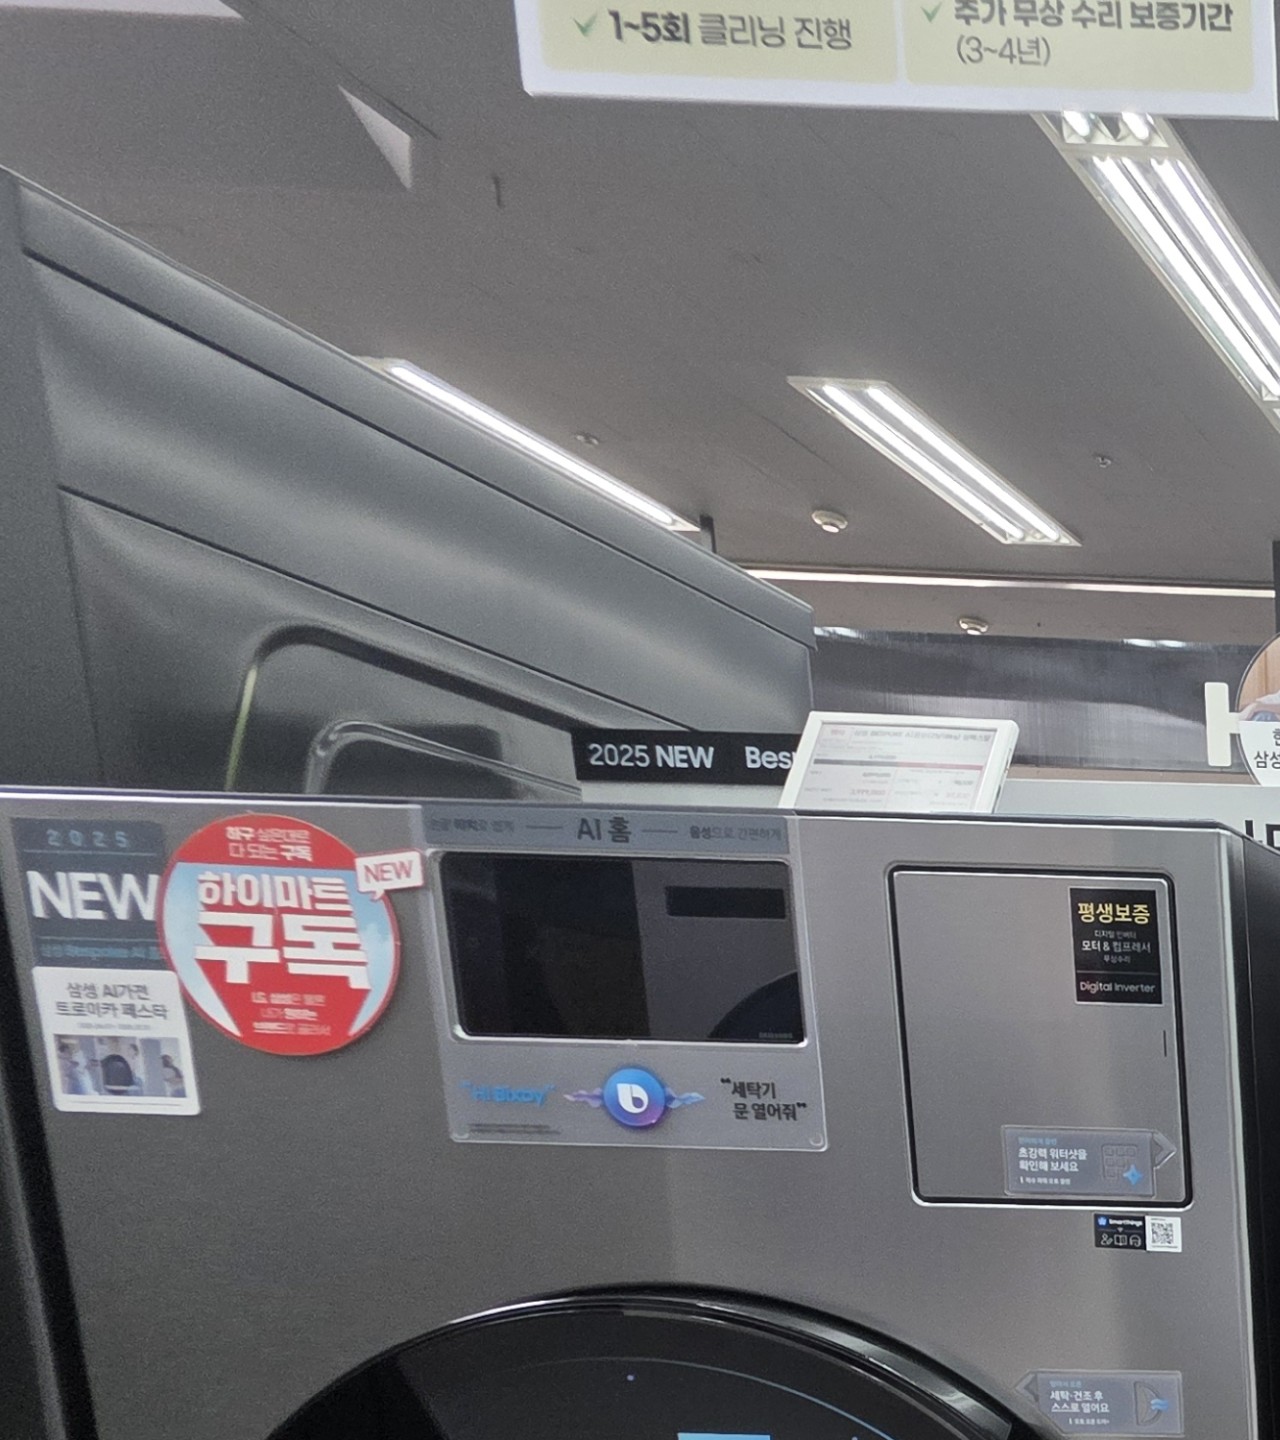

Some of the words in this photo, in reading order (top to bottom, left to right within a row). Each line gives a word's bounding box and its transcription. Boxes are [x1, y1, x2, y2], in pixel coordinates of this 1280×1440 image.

[607, 11, 690, 44] 1~5회
[698, 14, 787, 48] 클리닝
[793, 18, 853, 50] 진행
[1013, 0, 1065, 28] 무상
[1071, 0, 1121, 30] 수리
[1129, 0, 1233, 32] 보증기간
[955, 35, 1051, 66] (3~4년)
[588, 743, 650, 768] 2025
[656, 746, 715, 770] NEW
[745, 746, 798, 770] Bes
[577, 817, 601, 841] AI
[608, 817, 632, 843] 홈
[363, 859, 413, 883] NEW
[27, 871, 158, 920] NEW
[199, 871, 353, 911] 하이마트
[1078, 903, 1150, 924] 평생보증
[195, 911, 372, 990] 구독
[1080, 981, 1113, 994] Digital
[1114, 983, 1155, 993] Inverter
[1051, 1403, 1080, 1413] 스스로
